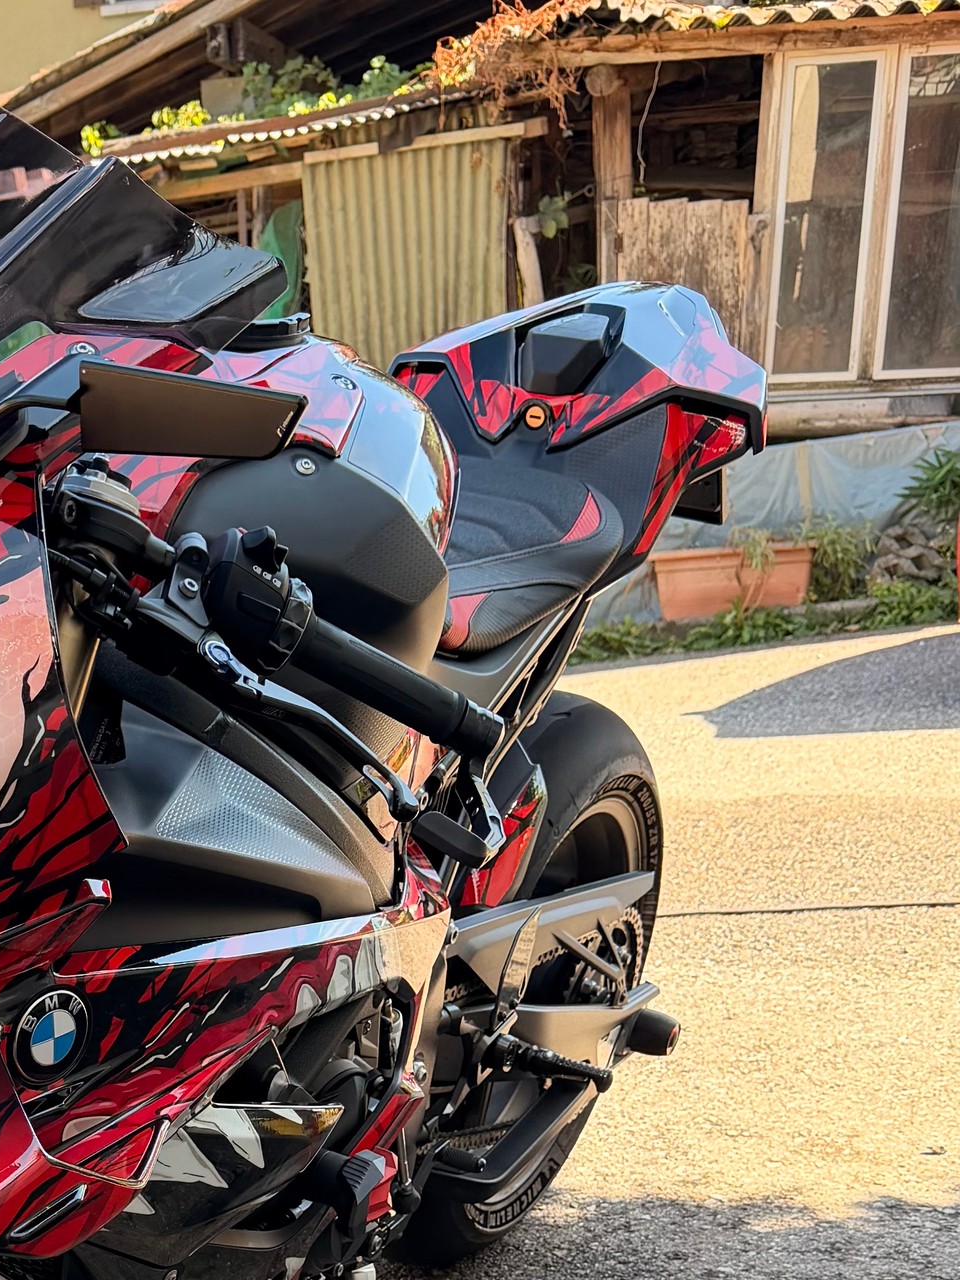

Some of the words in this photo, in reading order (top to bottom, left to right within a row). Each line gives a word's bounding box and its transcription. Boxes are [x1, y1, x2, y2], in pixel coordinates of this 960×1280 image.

[637, 787, 656, 825] 200/55
[649, 826, 658, 847] ZR
[649, 849, 658, 865] 17
[22, 994, 82, 1032] BMW
[489, 1177, 543, 1227] MICHELIN
